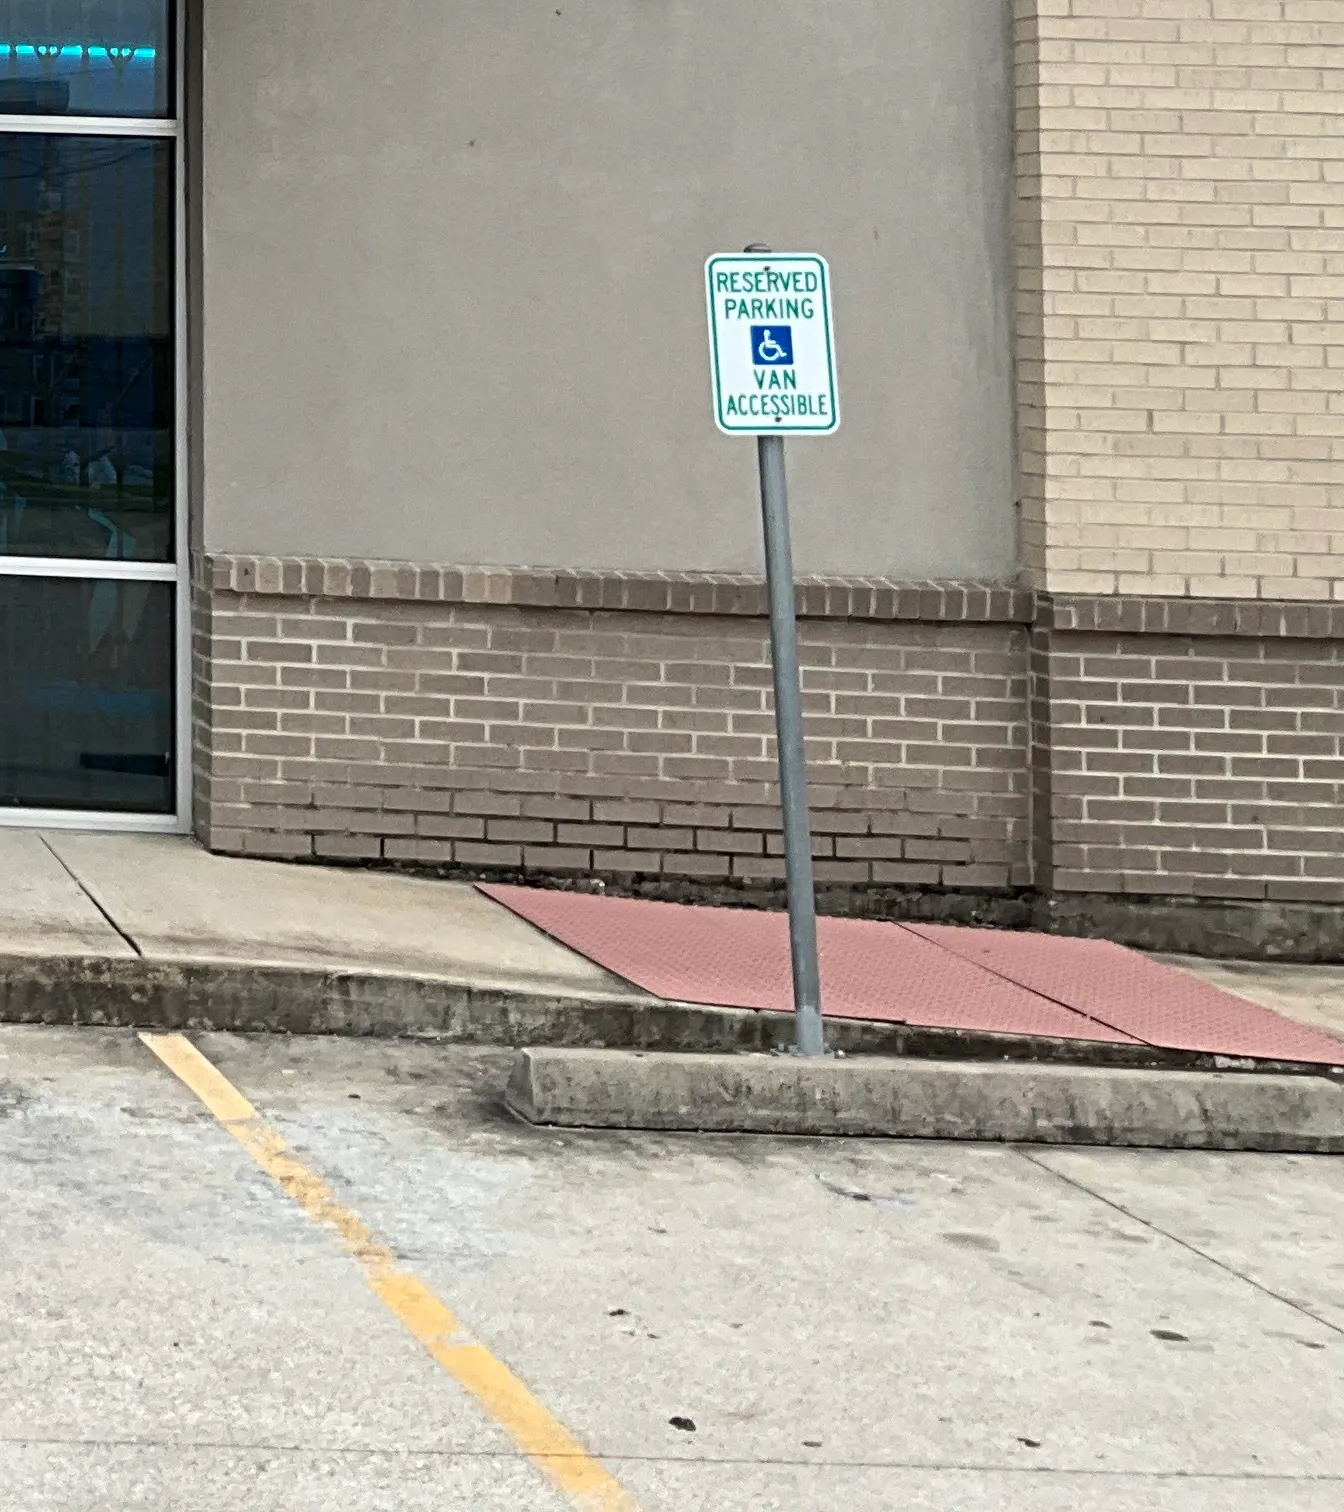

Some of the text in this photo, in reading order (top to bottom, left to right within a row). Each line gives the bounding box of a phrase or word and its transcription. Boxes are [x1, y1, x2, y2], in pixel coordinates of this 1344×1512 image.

[716, 271, 818, 293] RESERVED
[724, 297, 815, 320] PARKING
[753, 368, 797, 390] VAN
[726, 394, 828, 416] ACCESSIBLE
